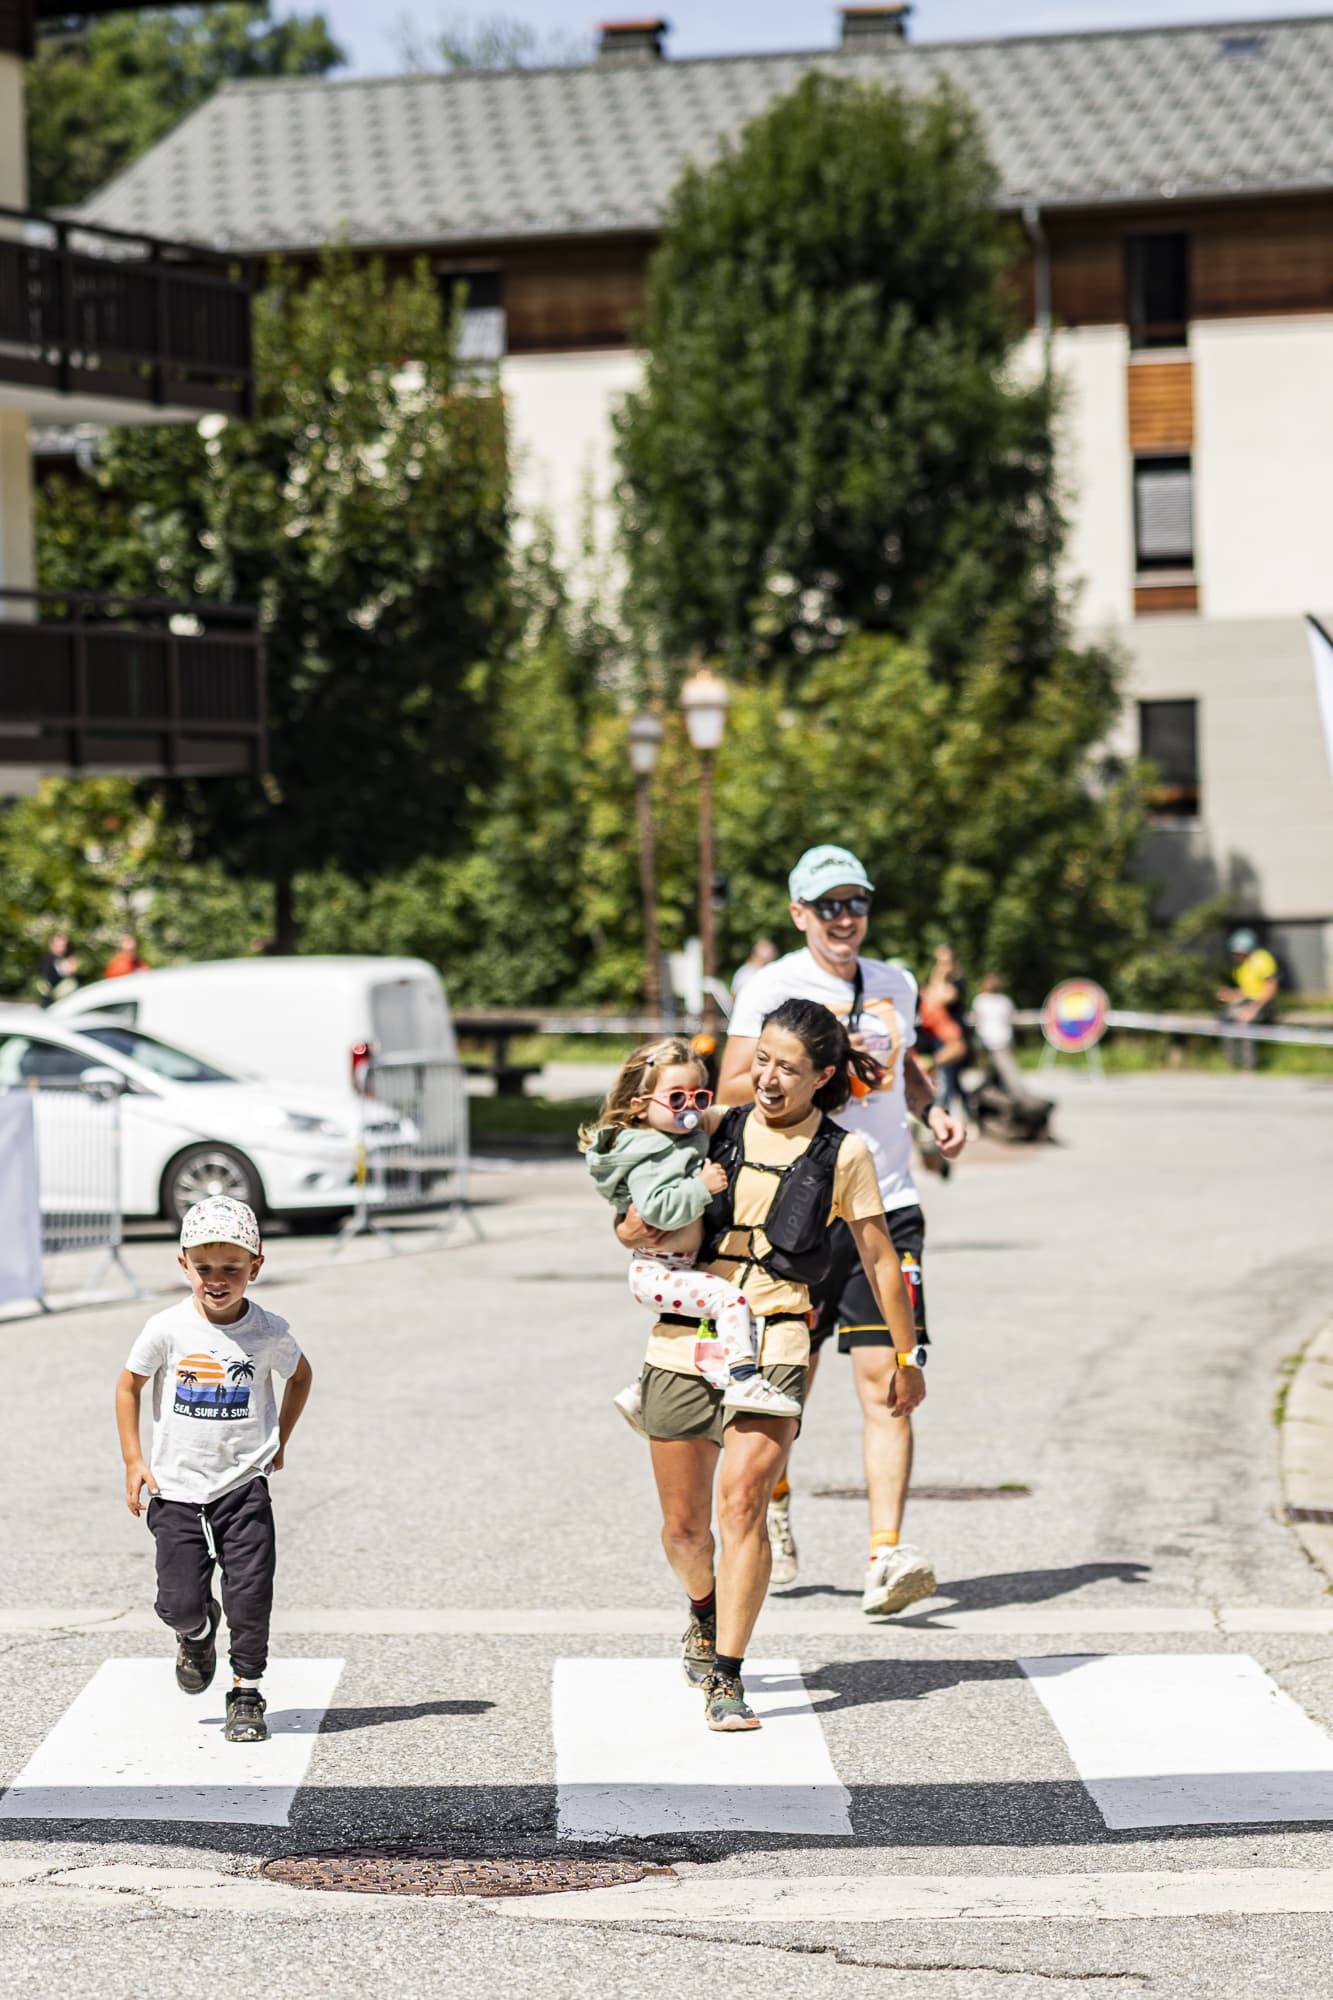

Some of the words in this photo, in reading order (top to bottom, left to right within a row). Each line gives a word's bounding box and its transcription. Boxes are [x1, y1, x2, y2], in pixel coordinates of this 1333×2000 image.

[174, 1403, 192, 1416] SEA,
[194, 1407, 219, 1417] SURF
[221, 1407, 229, 1418] &
[231, 1408, 249, 1418] SUN
